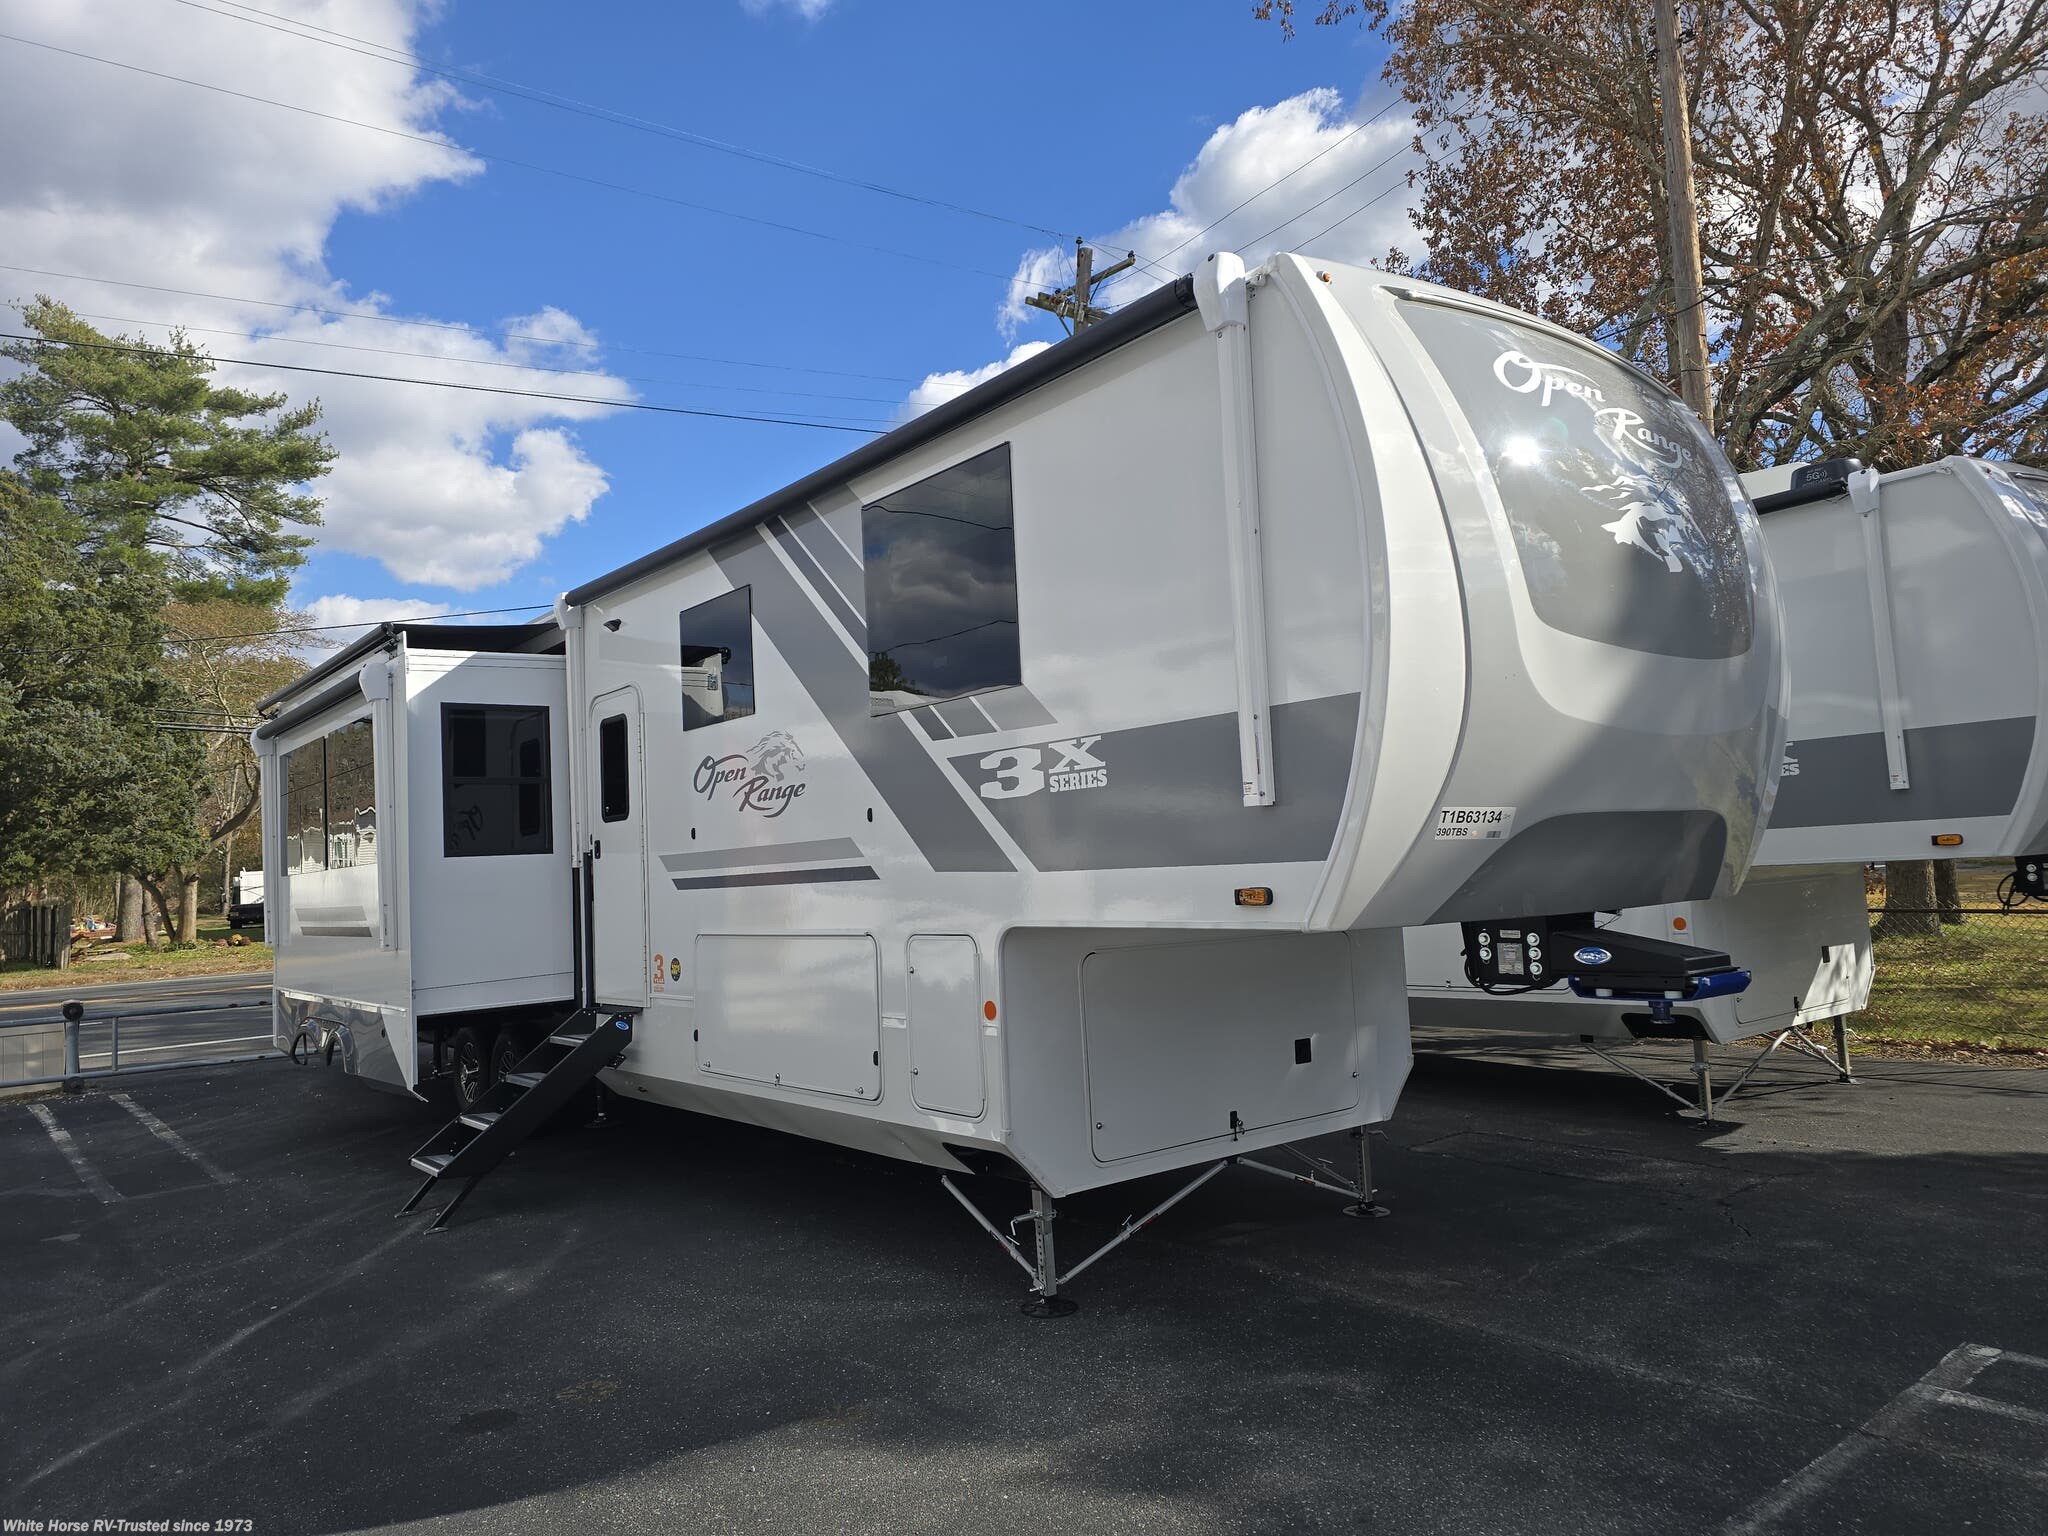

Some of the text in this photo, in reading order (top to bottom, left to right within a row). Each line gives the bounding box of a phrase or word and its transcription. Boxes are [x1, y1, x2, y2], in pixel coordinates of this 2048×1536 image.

[1493, 350, 1692, 469] Open Range
[693, 754, 806, 818] Open Range
[1049, 768, 1108, 793] SERIES
[1441, 810, 1503, 824] T1B63134
[1436, 827, 1469, 837] 390TBS
